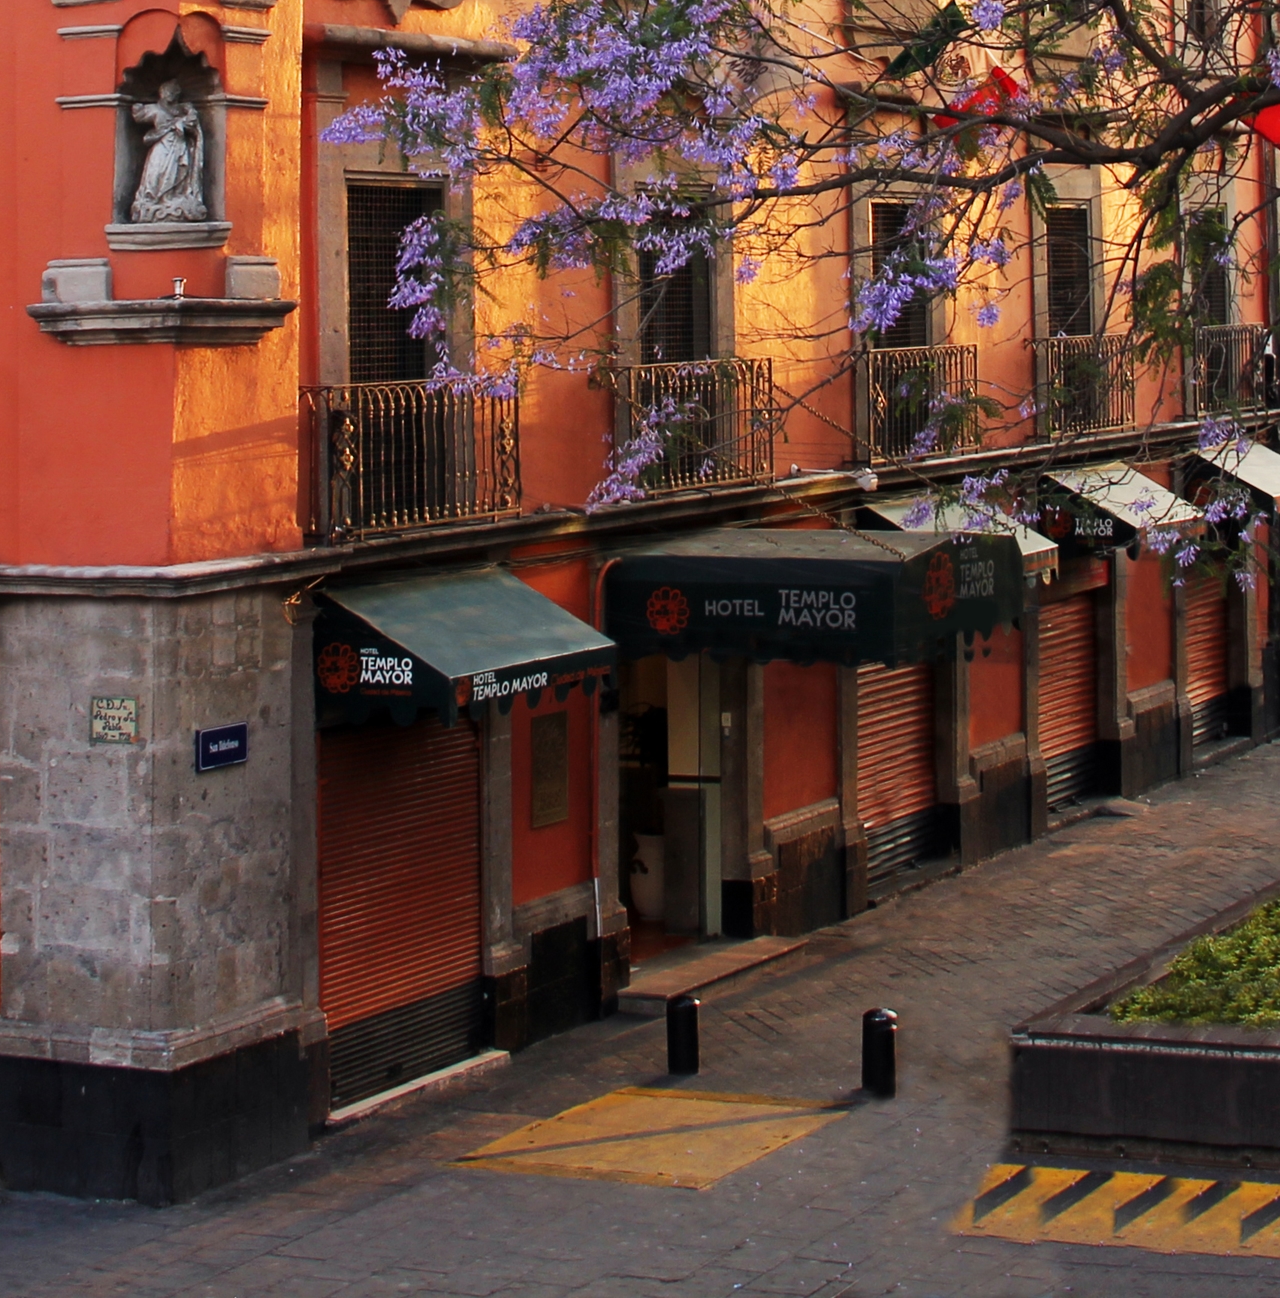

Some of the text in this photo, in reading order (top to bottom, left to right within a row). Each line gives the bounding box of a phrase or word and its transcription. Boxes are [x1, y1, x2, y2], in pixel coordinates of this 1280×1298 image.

[959, 547, 978, 560] HOTEL
[960, 560, 994, 582] TEMPLO
[960, 578, 994, 598] MAYOR
[705, 600, 765, 616] HOTEL
[778, 590, 856, 609] TEMPLO
[778, 608, 856, 628] MAYOR
[360, 657, 412, 671] TEMPLO
[360, 670, 412, 685] MAYOR
[473, 672, 496, 685] HOTEL
[473, 672, 548, 701] TEMPLO MAYOR
